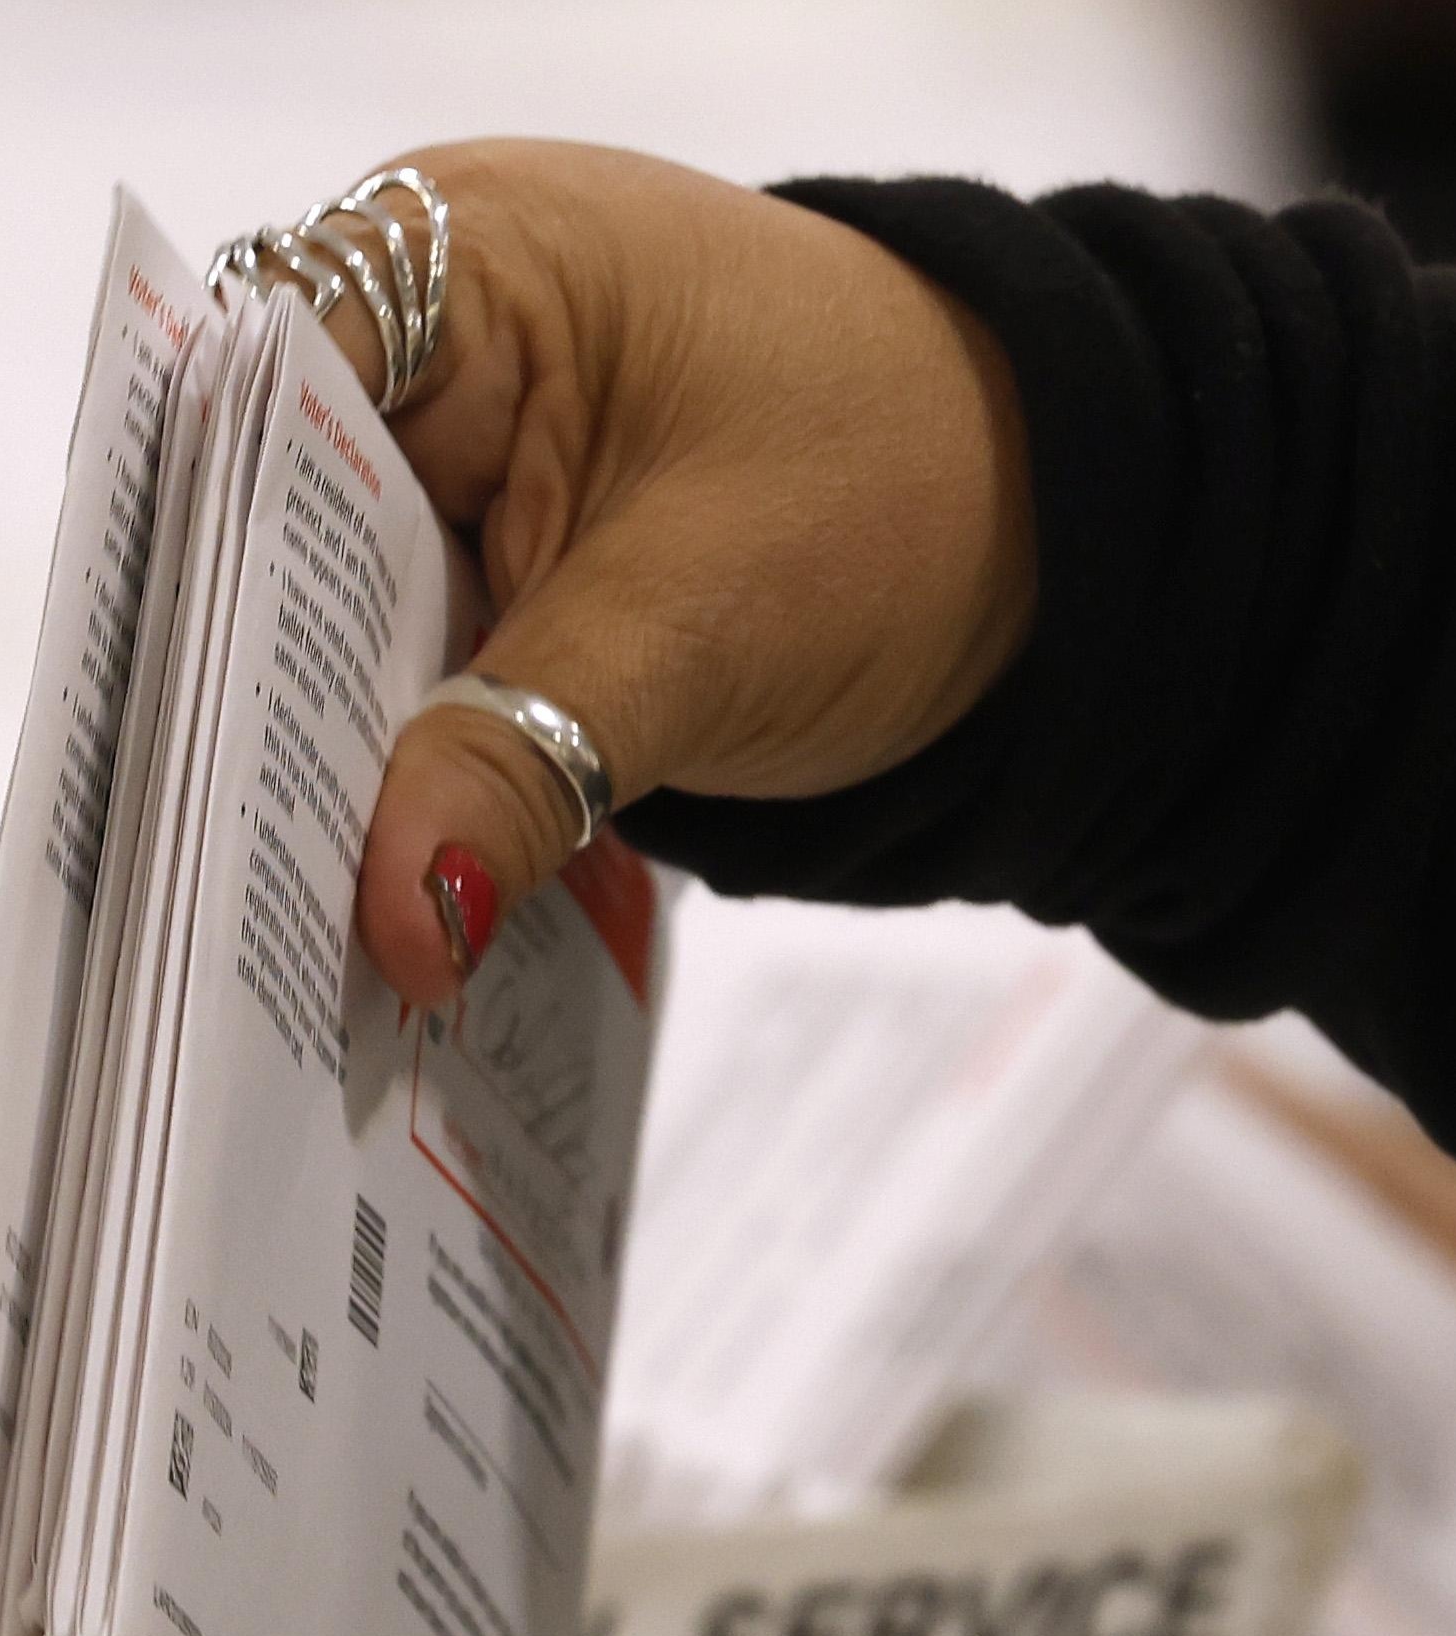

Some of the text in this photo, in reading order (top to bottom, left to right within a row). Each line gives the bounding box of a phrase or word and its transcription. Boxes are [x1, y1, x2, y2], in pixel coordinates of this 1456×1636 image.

[299, 380, 381, 500] Voter's Declaration
[299, 453, 315, 483] am
[320, 476, 354, 526] resident
[352, 511, 365, 538] of
[323, 527, 342, 558] and
[344, 548, 359, 576] am
[277, 601, 305, 649] ballot
[304, 627, 323, 670] from
[273, 694, 300, 743] declare
[259, 763, 277, 796] and
[263, 724, 280, 760] this
[299, 770, 308, 799] to
[249, 849, 285, 906] compared
[258, 819, 296, 879] understand
[240, 916, 256, 949] the
